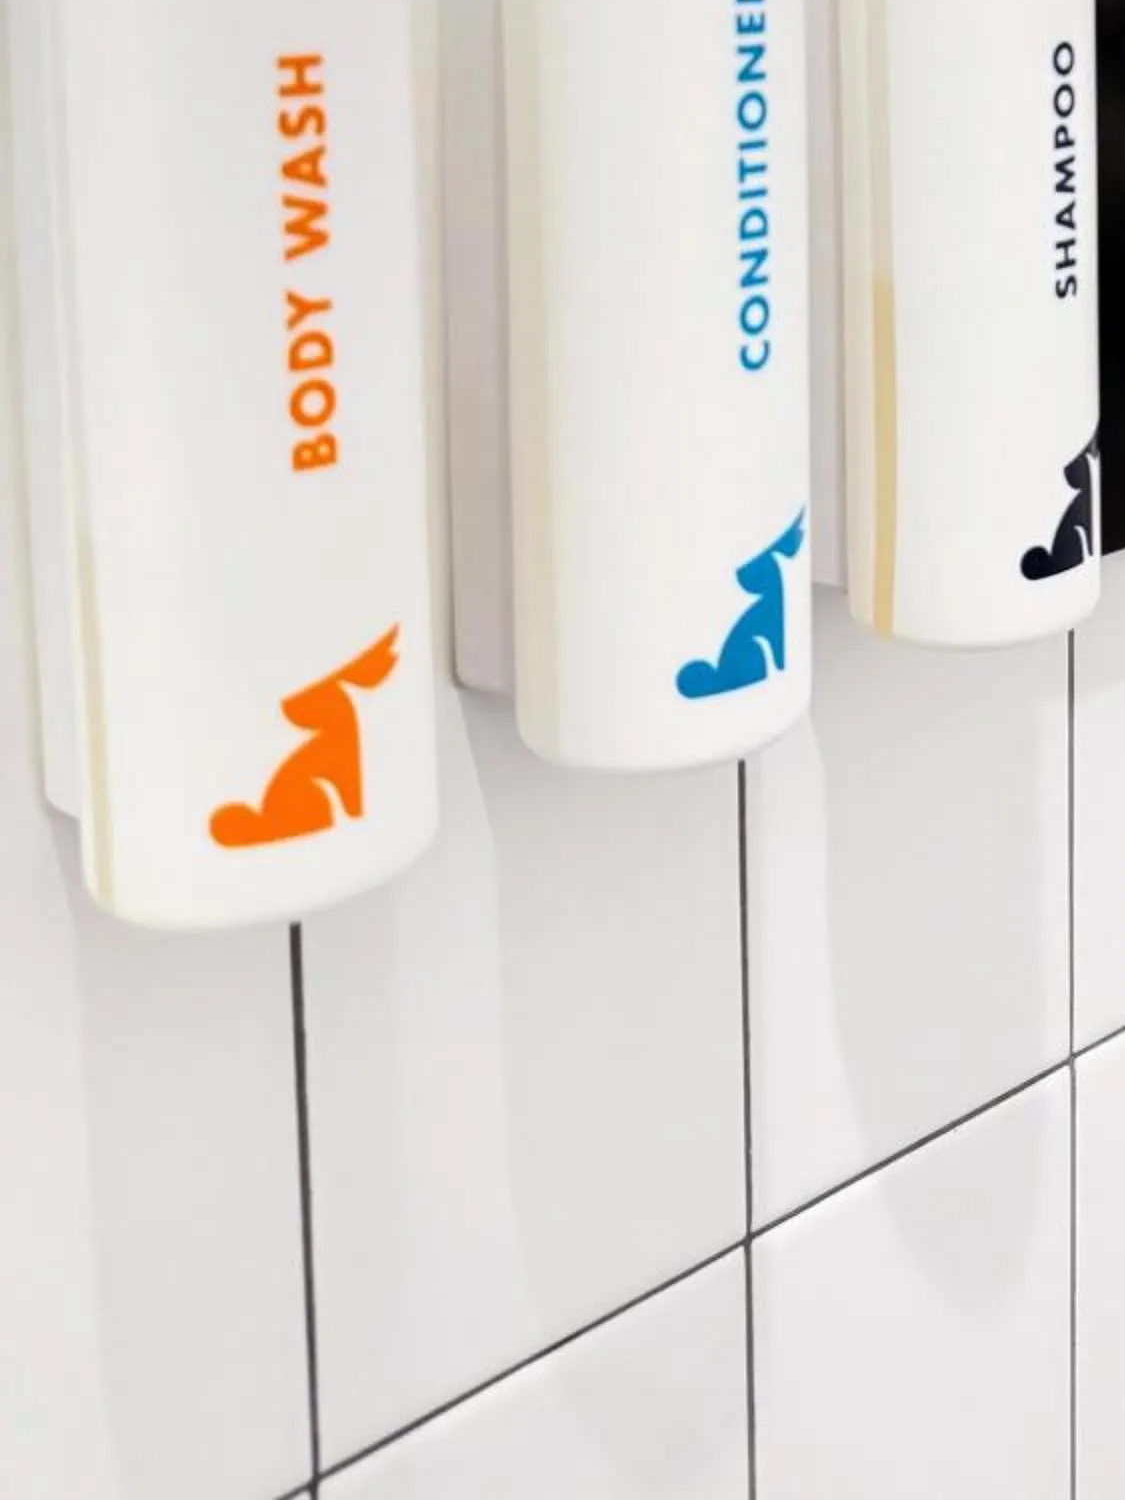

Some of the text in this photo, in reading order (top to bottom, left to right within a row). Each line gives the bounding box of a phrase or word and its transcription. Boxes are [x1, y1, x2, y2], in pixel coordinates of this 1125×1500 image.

[275, 52, 340, 474] BODY WASH
[1052, 41, 1077, 299] SHAMPOO
